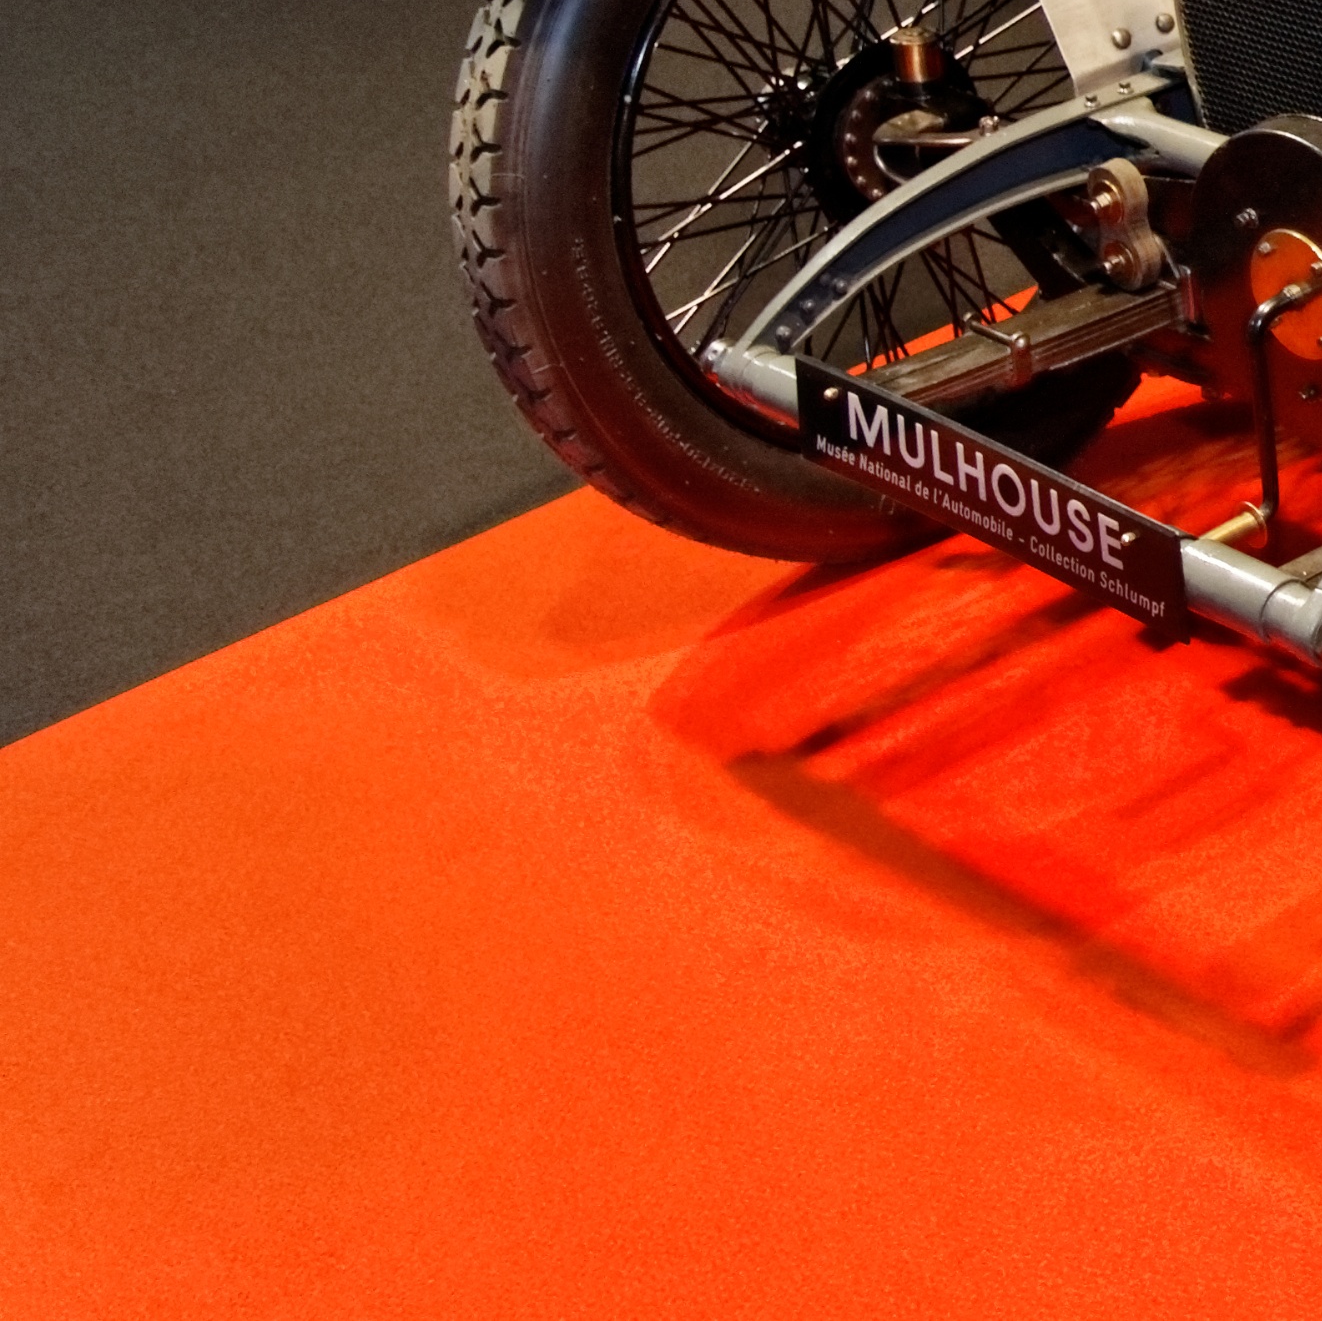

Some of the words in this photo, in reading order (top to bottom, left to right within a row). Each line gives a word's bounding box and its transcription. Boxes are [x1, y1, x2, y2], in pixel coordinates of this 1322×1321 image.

[816, 433, 856, 466] Musée
[858, 452, 912, 493] National
[914, 479, 931, 503] de
[933, 489, 1014, 541] l'Automobile
[1029, 534, 1096, 584] Collection
[1099, 570, 1165, 619] Schlumpf
[847, 391, 1124, 571] MULHOUSE
